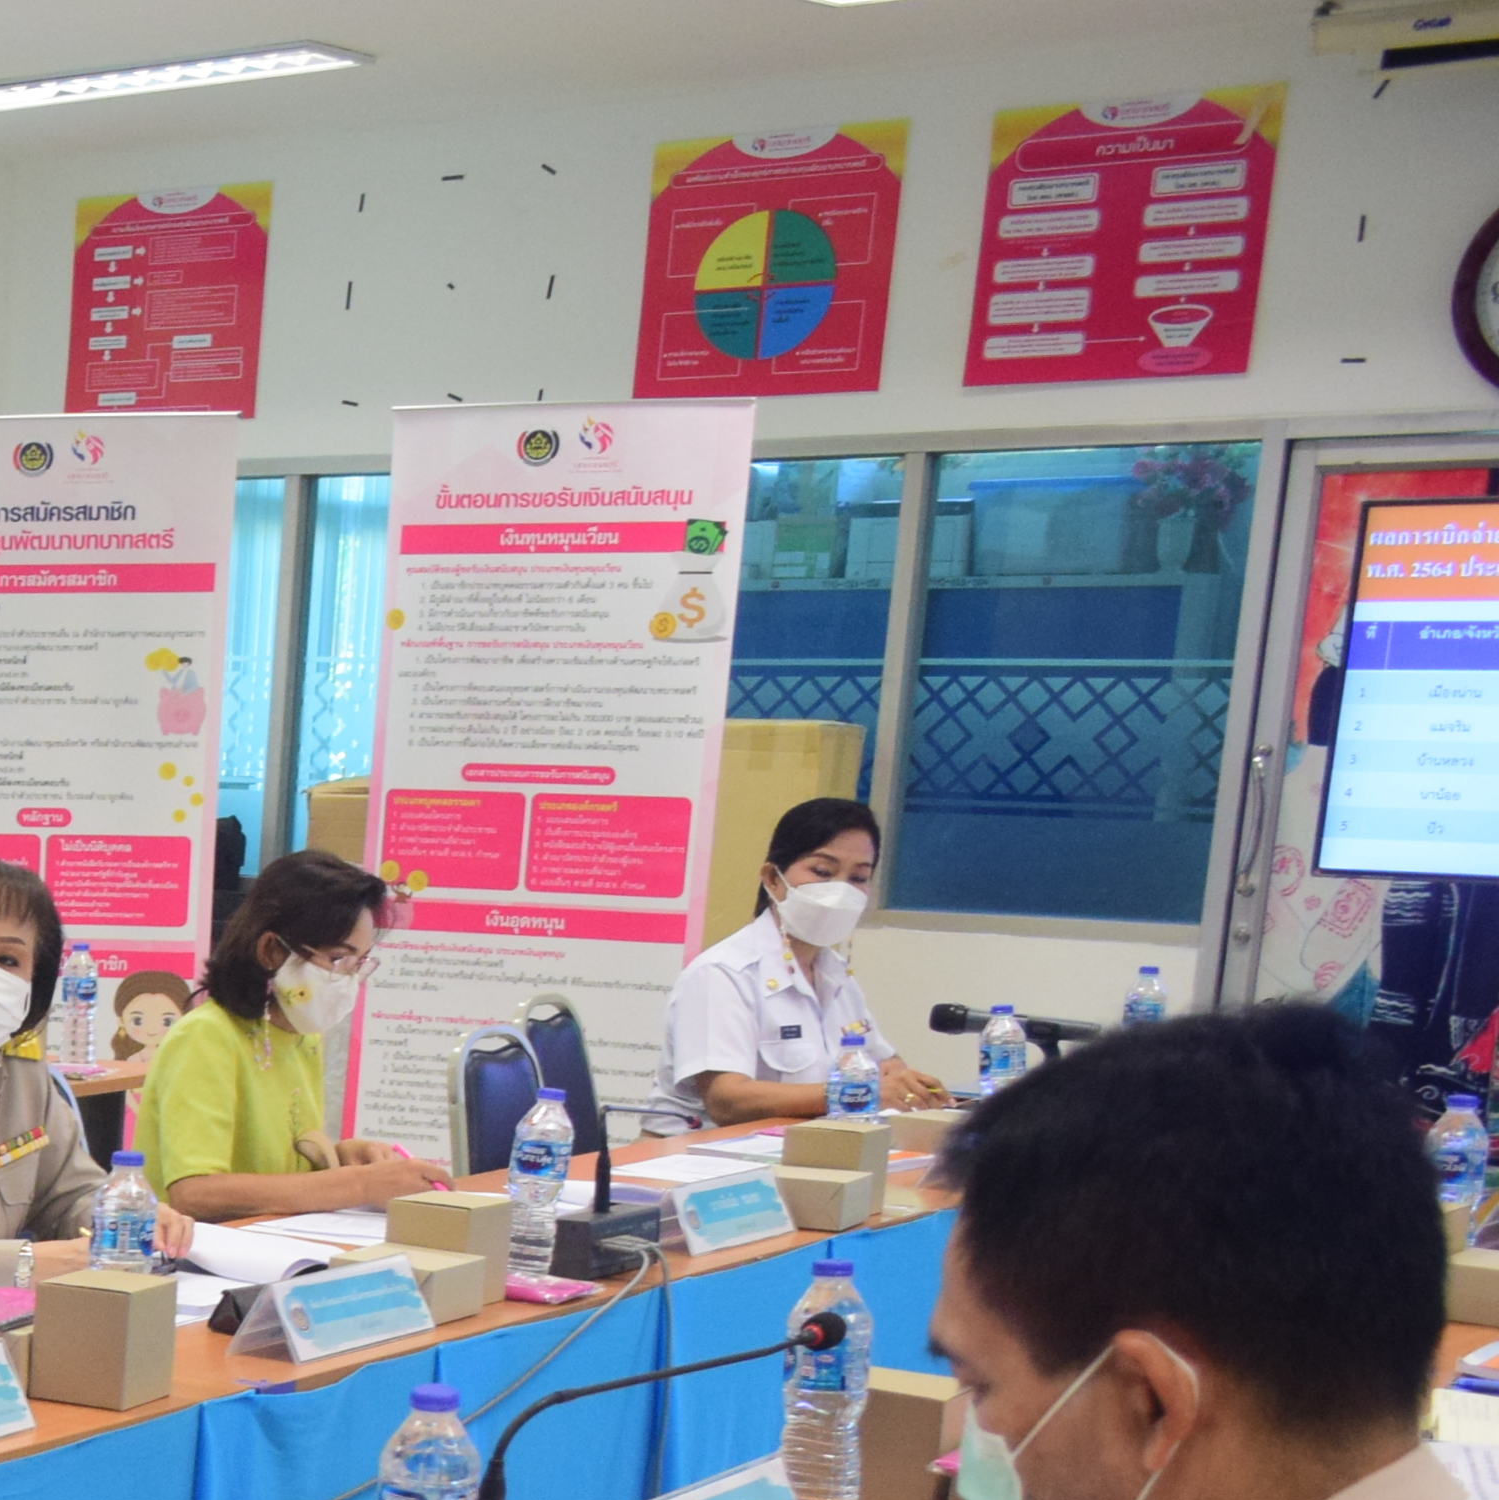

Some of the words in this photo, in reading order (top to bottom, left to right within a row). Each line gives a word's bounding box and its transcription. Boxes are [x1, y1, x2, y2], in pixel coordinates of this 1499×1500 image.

[1095, 135, 1175, 157] ความเป็นมา
[435, 483, 693, 512] ขั้นตอนการขอรับเงินสนับสนุน
[499, 527, 620, 552] เงินทุนหมุนเวียน
[1367, 562, 1405, 578] พ.ศ.
[1410, 561, 1454, 578] 2564
[0, 570, 118, 588] การสมัครสมาชิก
[1358, 686, 1366, 699] 1
[1428, 681, 1483, 700] เมืองน่าน
[1353, 719, 1363, 732] 2
[1429, 717, 1472, 735] แม่จริม
[1349, 753, 1357, 766] 3
[1417, 750, 1475, 769] บ้านหลวง
[1344, 786, 1353, 799] 4
[1419, 784, 1462, 802] นาน้อย
[22, 811, 64, 826] หลักฐาน
[1339, 819, 1349, 832] 5
[485, 909, 566, 936] เงินอุดหนุน
